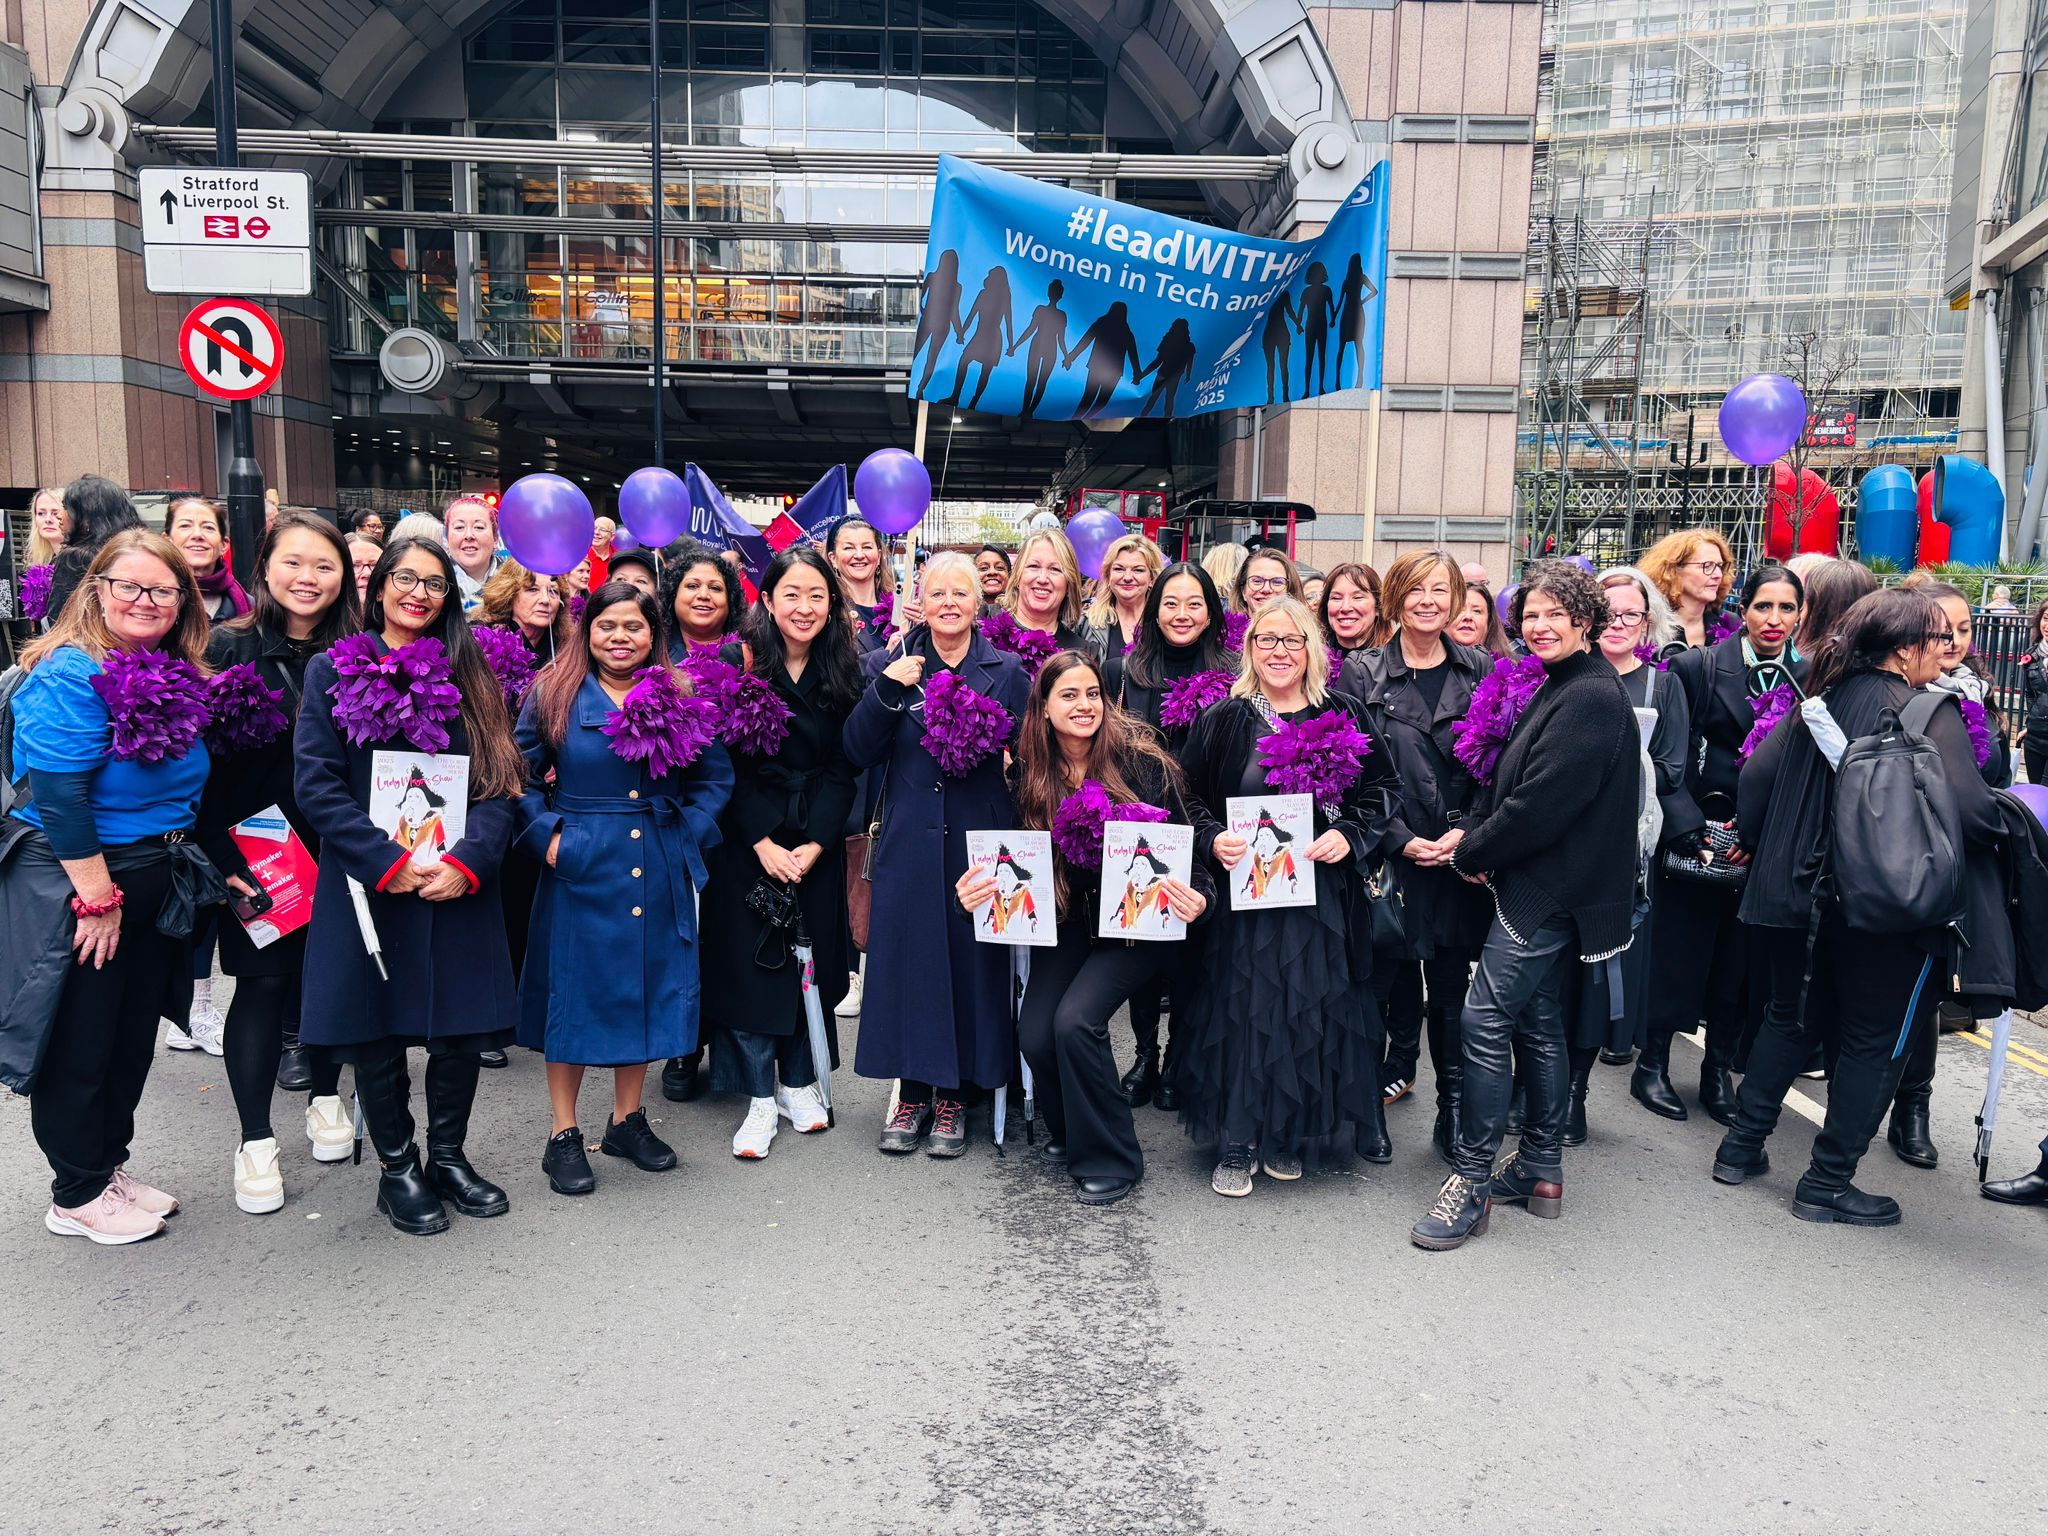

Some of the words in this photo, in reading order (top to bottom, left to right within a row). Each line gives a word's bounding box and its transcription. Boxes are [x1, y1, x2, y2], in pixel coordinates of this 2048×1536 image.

[183, 176, 259, 191] Stratford
[183, 194, 259, 211] Liverpool
[266, 196, 290, 210] St.
[1005, 228, 1112, 284] Women
[1119, 263, 1147, 294] in
[1154, 272, 1218, 311] Tech
[1225, 284, 1278, 313] and
[488, 288, 547, 303] Collins
[583, 290, 640, 304] Collins
[704, 293, 762, 307] Collins
[1825, 418, 1836, 426] WE
[1813, 426, 1847, 435] REMEMBER
[702, 537, 720, 550] Royal
[376, 775, 400, 791] Lady
[432, 774, 453, 785] Show
